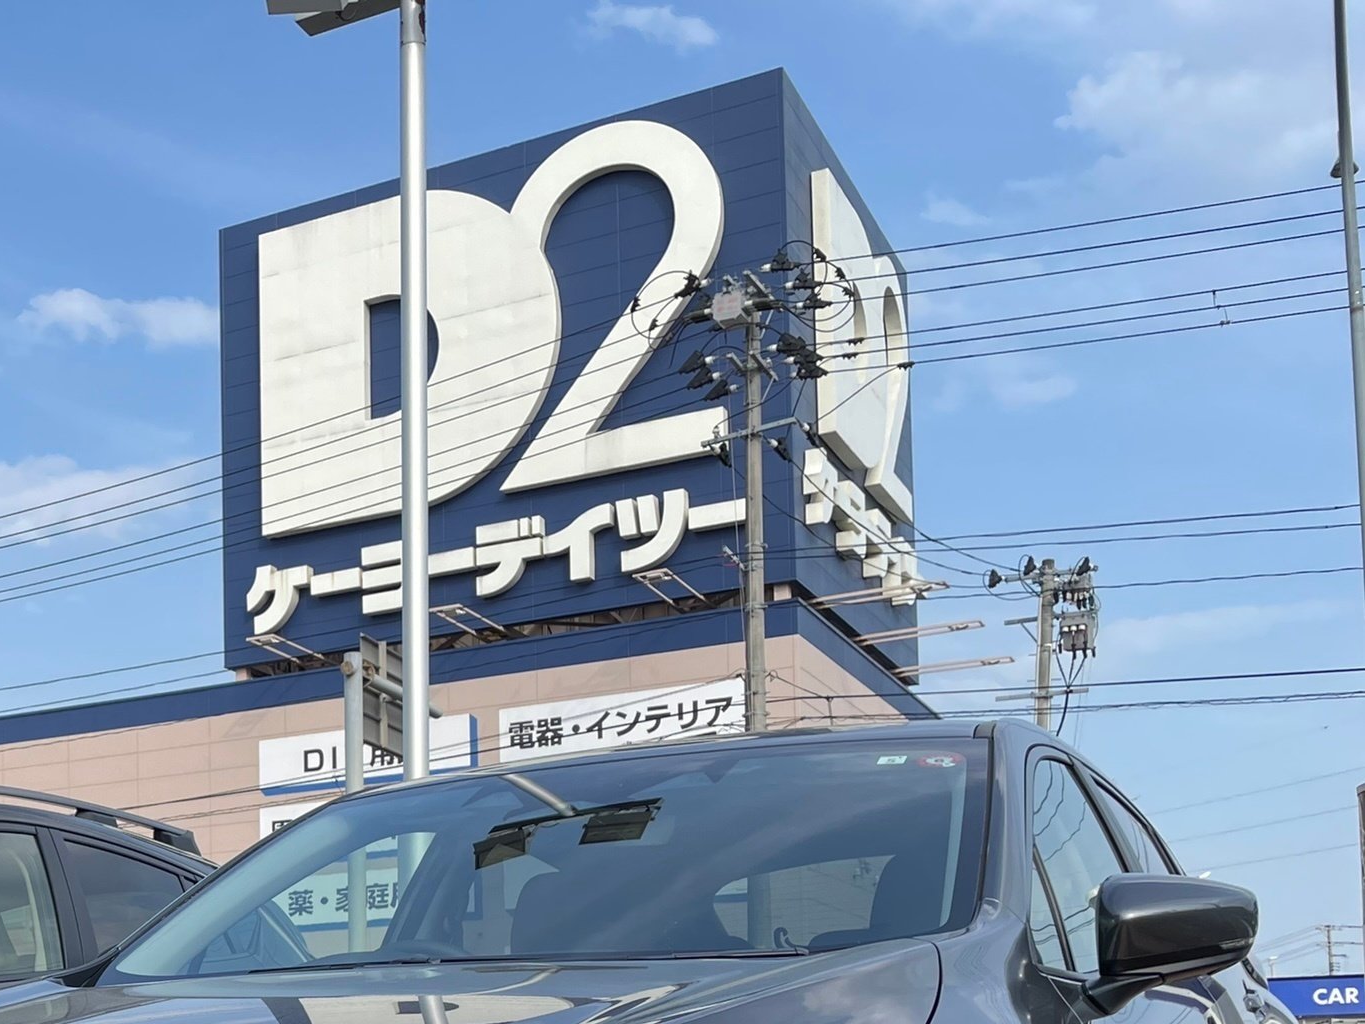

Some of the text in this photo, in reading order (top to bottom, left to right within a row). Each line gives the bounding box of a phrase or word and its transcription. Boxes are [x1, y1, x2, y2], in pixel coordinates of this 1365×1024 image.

[258, 119, 729, 539] D2
[508, 696, 733, 750] 電器・インテリア
[1312, 986, 1360, 1006] CAR
